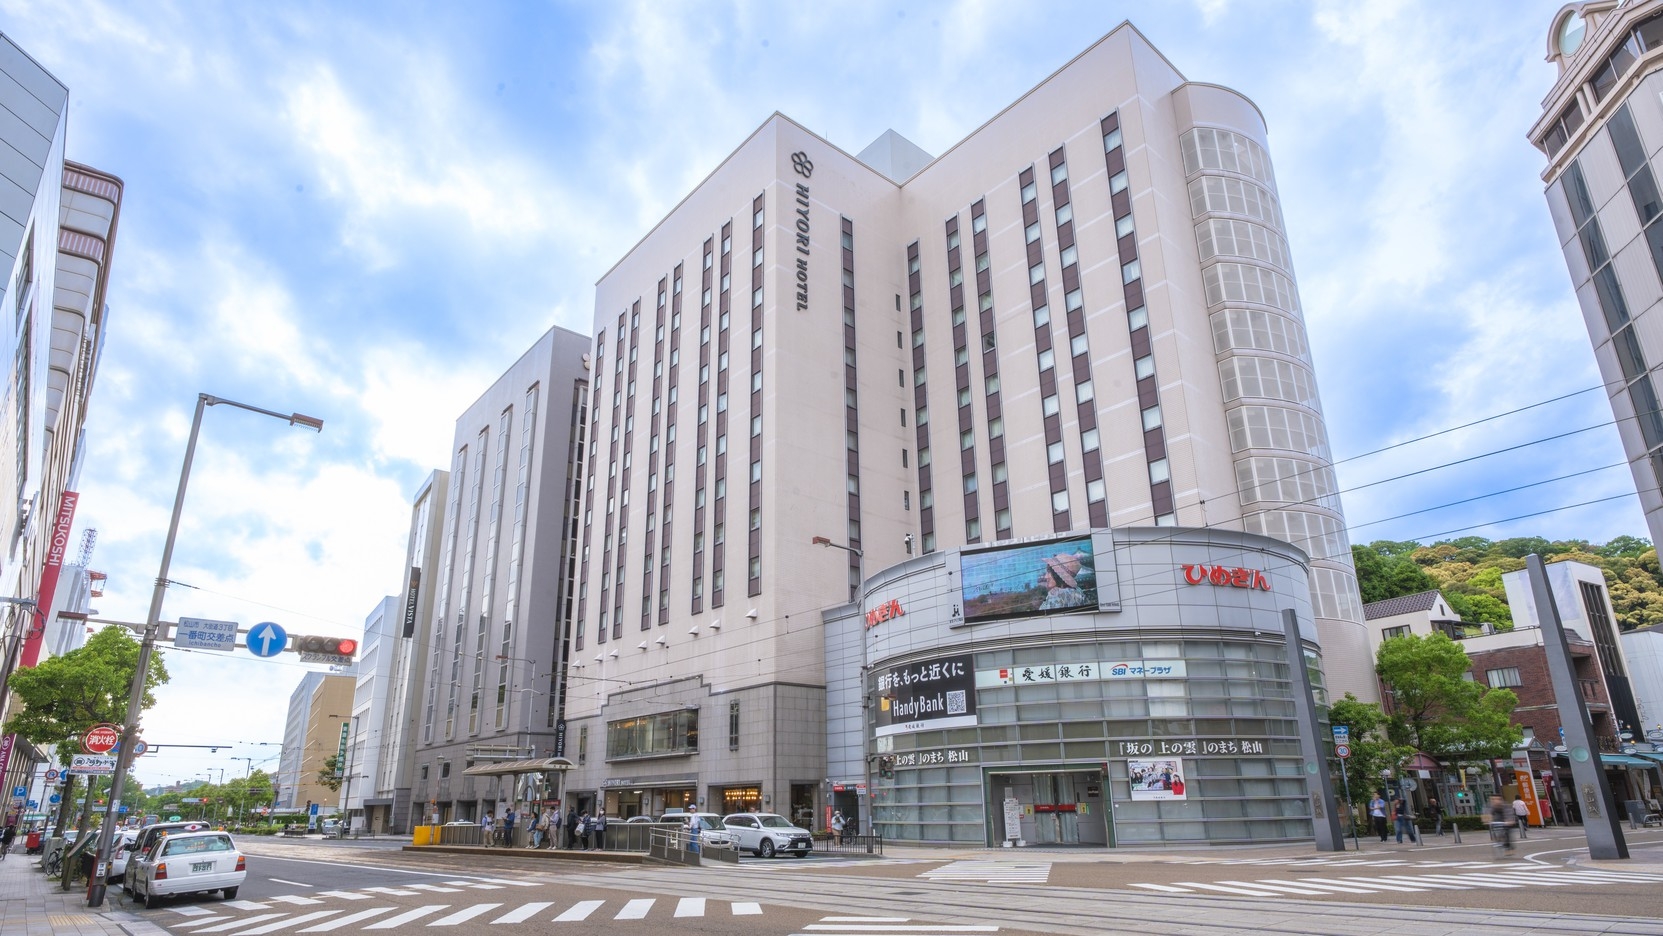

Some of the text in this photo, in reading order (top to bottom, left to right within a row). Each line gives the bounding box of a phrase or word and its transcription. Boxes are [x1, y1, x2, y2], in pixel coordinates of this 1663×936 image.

[796, 183, 810, 312] HIYORI HOTEL
[49, 496, 75, 566] MITSUKOSHI
[1181, 563, 1271, 591] ひめぎん
[406, 605, 415, 624] VISTA
[178, 630, 234, 643] 一番町交差点
[302, 651, 350, 663] スクランブル交差点
[878, 662, 965, 691] 銀行を、もっと近くに
[1021, 665, 1092, 682] 愛媛銀行
[1111, 666, 1172, 676] SBI マネープラザ
[893, 693, 945, 719] HandyBank
[88, 734, 116, 746] 消火栓
[1339, 747, 1348, 755] 30
